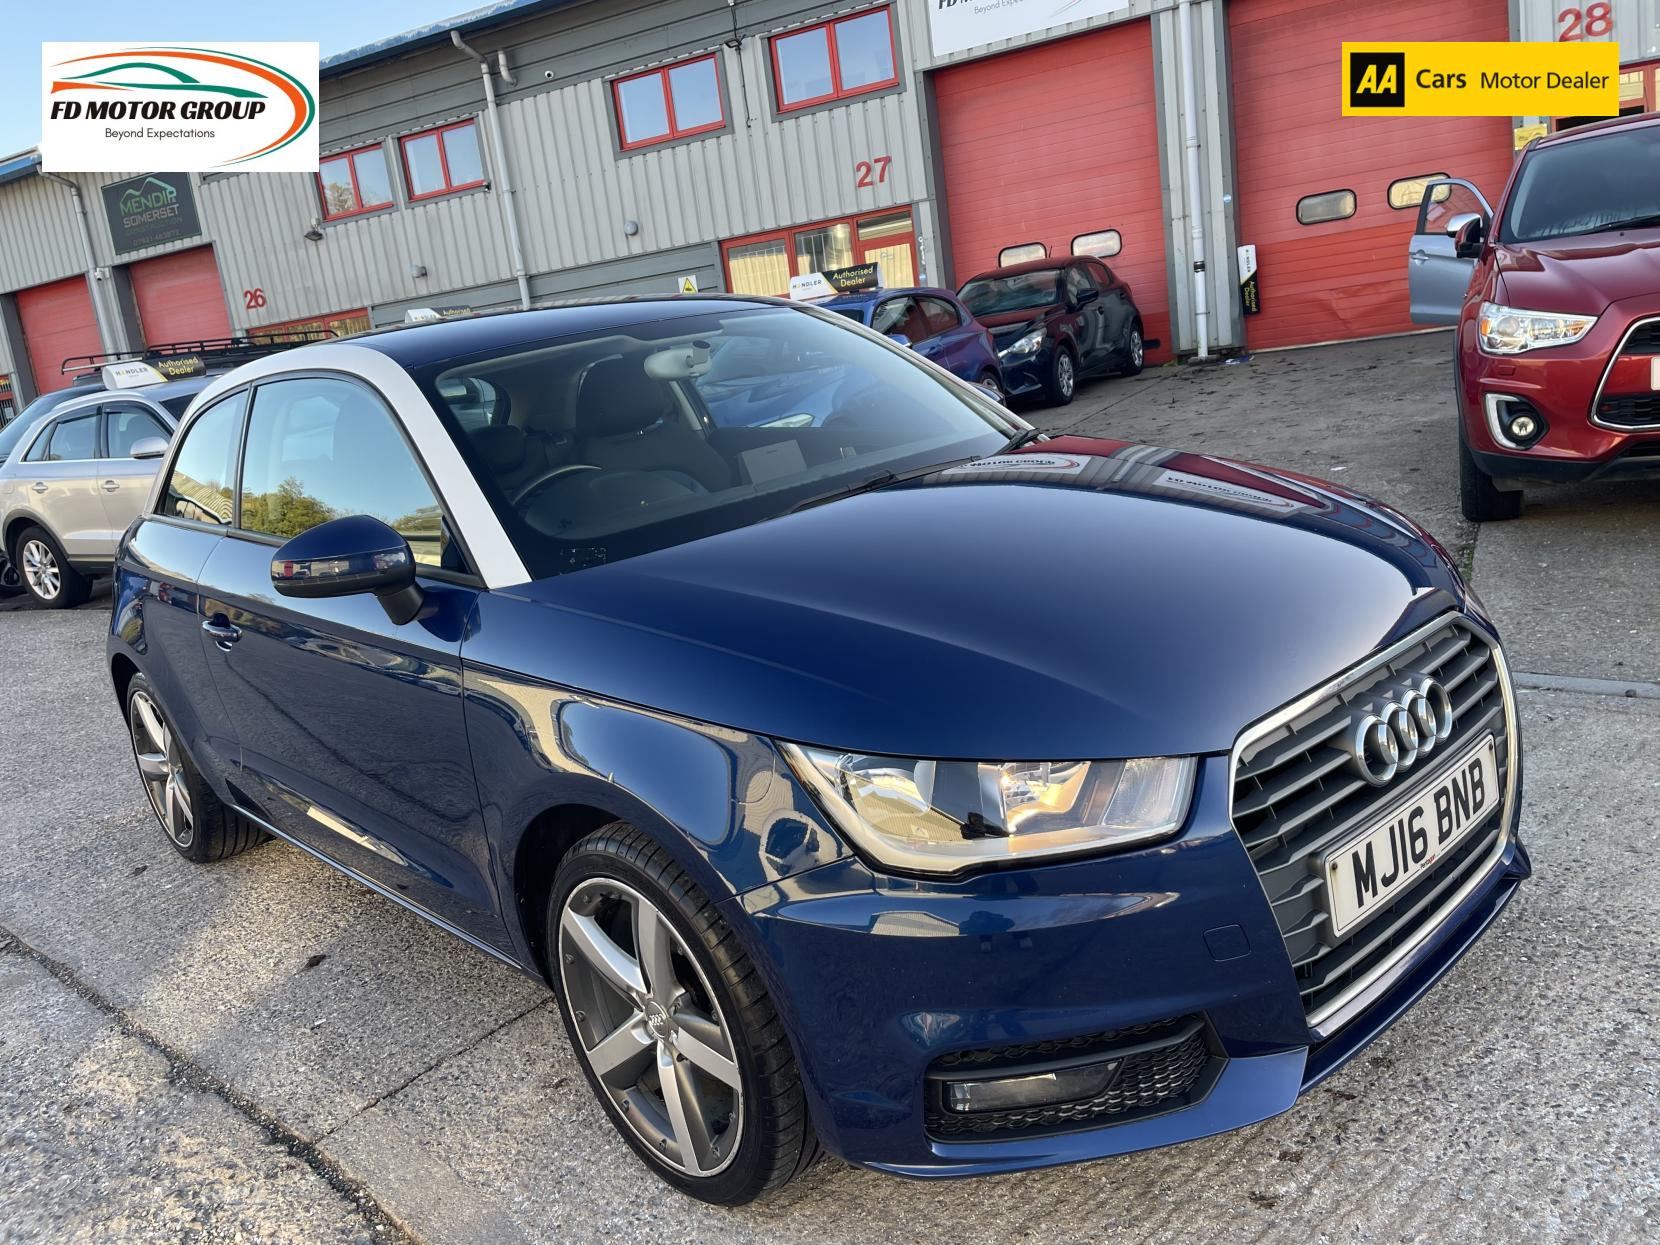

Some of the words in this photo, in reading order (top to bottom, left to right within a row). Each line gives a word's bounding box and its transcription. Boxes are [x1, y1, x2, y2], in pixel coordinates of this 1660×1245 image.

[1557, 2, 1613, 42] 28
[856, 155, 892, 187] 27
[120, 187, 177, 215] MENDIP
[123, 203, 179, 228] SOMERSET
[833, 266, 874, 280] Authorised
[840, 277, 866, 287] Dealer
[244, 288, 266, 309] 26
[158, 356, 199, 368] Authorised
[168, 365, 194, 375] Dealer
[1352, 805, 1428, 909] MJ16
[1433, 757, 1485, 845] BNB
